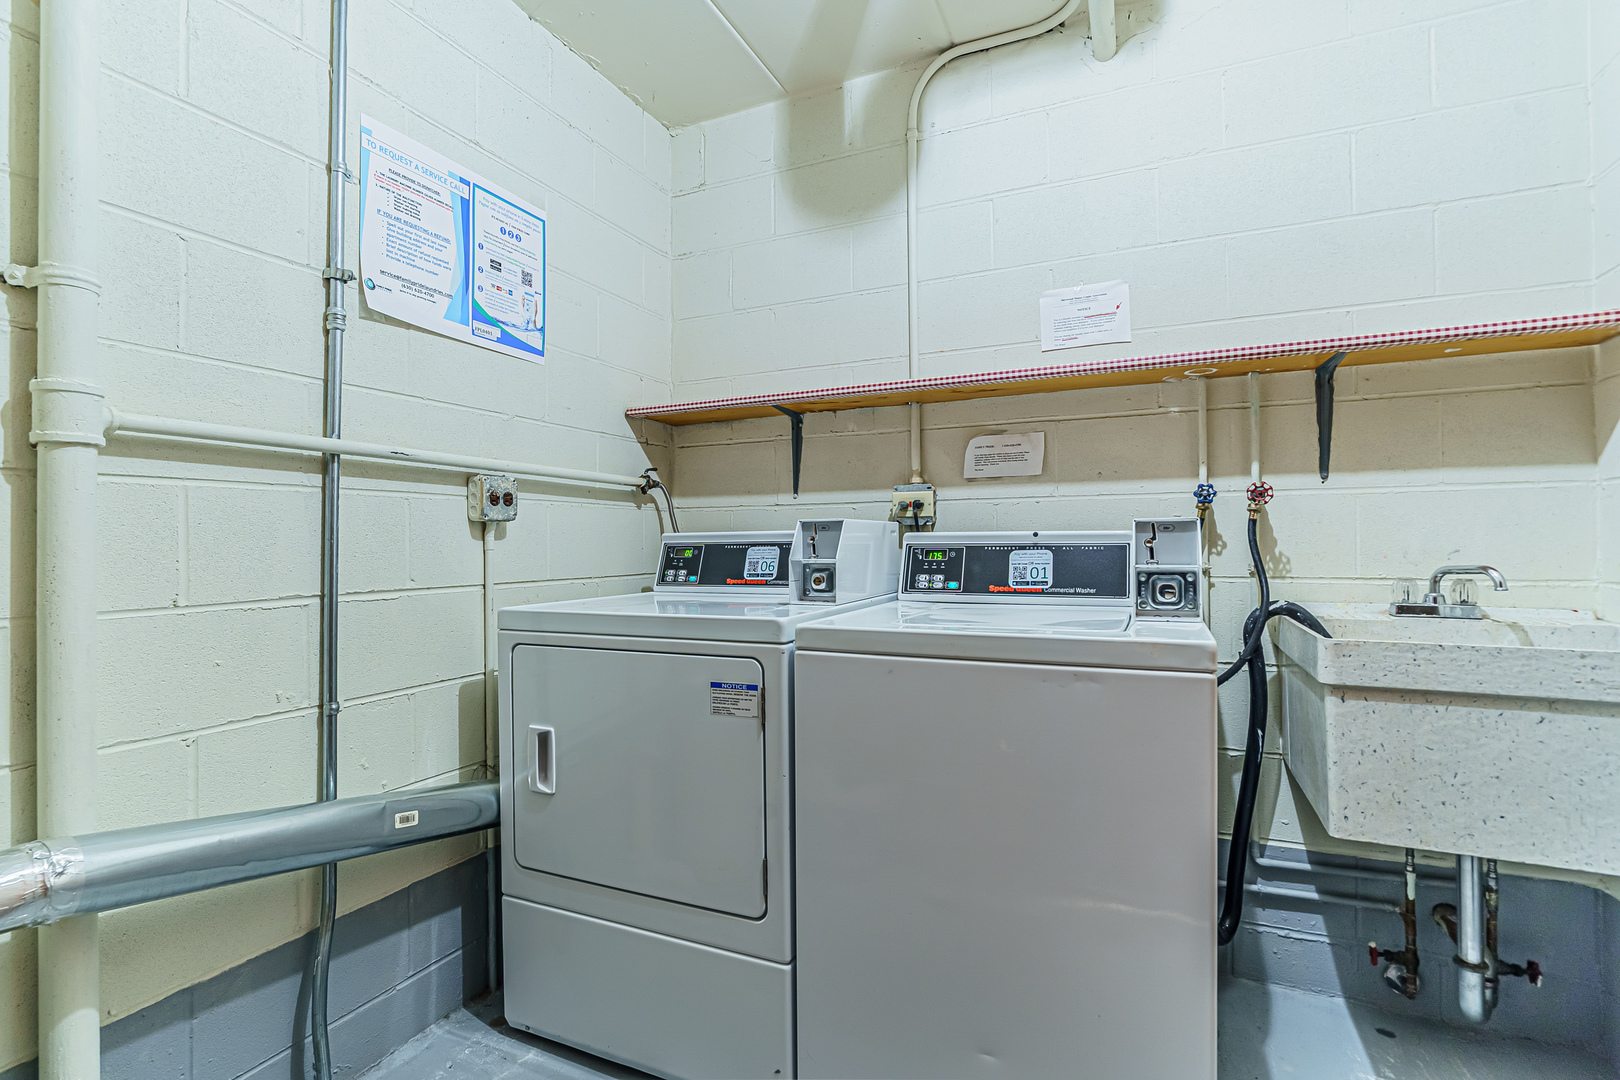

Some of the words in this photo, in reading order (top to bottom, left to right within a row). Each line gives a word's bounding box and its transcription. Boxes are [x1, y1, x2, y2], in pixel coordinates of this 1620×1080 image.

[366, 138, 376, 149] TO
[379, 145, 413, 167] REQUEST
[421, 166, 448, 185] SERVICE
[450, 181, 466, 194] CALL
[383, 210, 393, 220] YOU
[403, 220, 429, 235] REQUESTING
[386, 233, 407, 243] apartment
[408, 241, 422, 249] number
[396, 230, 412, 240] building
[413, 238, 426, 246] address
[397, 246, 418, 258] description
[398, 242, 412, 250] amount
[418, 249, 430, 258] refund
[431, 251, 449, 265] requested
[400, 253, 415, 262] machine
[386, 253, 401, 263] Provide
[406, 261, 424, 271] telephone
[761, 561, 775, 571] 06
[1030, 567, 1048, 579] 01
[989, 585, 1014, 593] Speed
